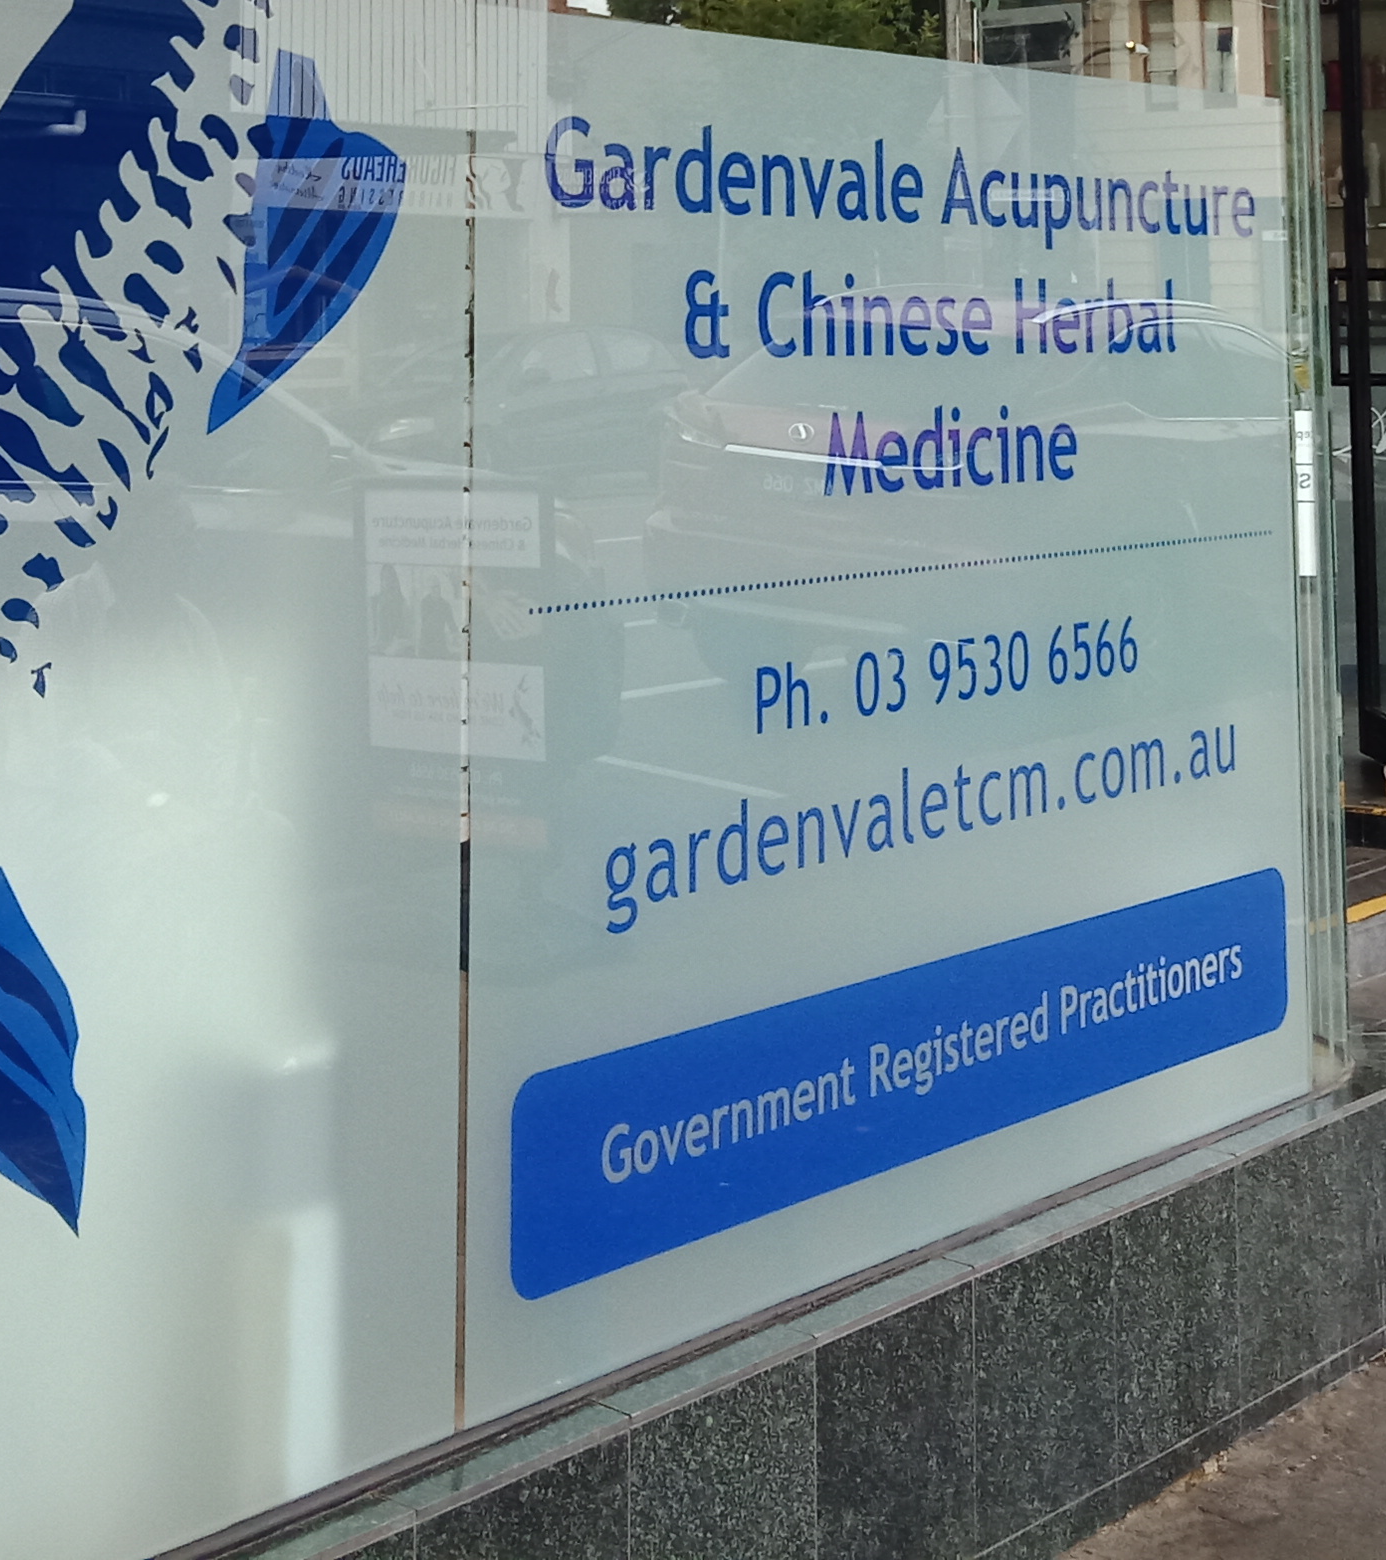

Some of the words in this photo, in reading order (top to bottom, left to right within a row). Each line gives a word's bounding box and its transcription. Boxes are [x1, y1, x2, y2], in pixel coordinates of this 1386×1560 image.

[544, 114, 923, 224] Gardenvale
[941, 146, 1256, 250] Acupuncture
[684, 269, 732, 360] &
[758, 269, 993, 358] Chinese
[1014, 277, 1178, 357] Herbal
[824, 405, 1078, 497] Medicine
[754, 661, 830, 735] Ph.
[854, 648, 907, 716] 03
[929, 629, 1030, 706] 9530
[1047, 615, 1141, 685] 6566
[604, 723, 1239, 934] gardenvaletcm.com.au
[601, 1057, 857, 1185] Government
[868, 1000, 1050, 1100] Registered
[1059, 937, 1244, 1038] Practitioners
